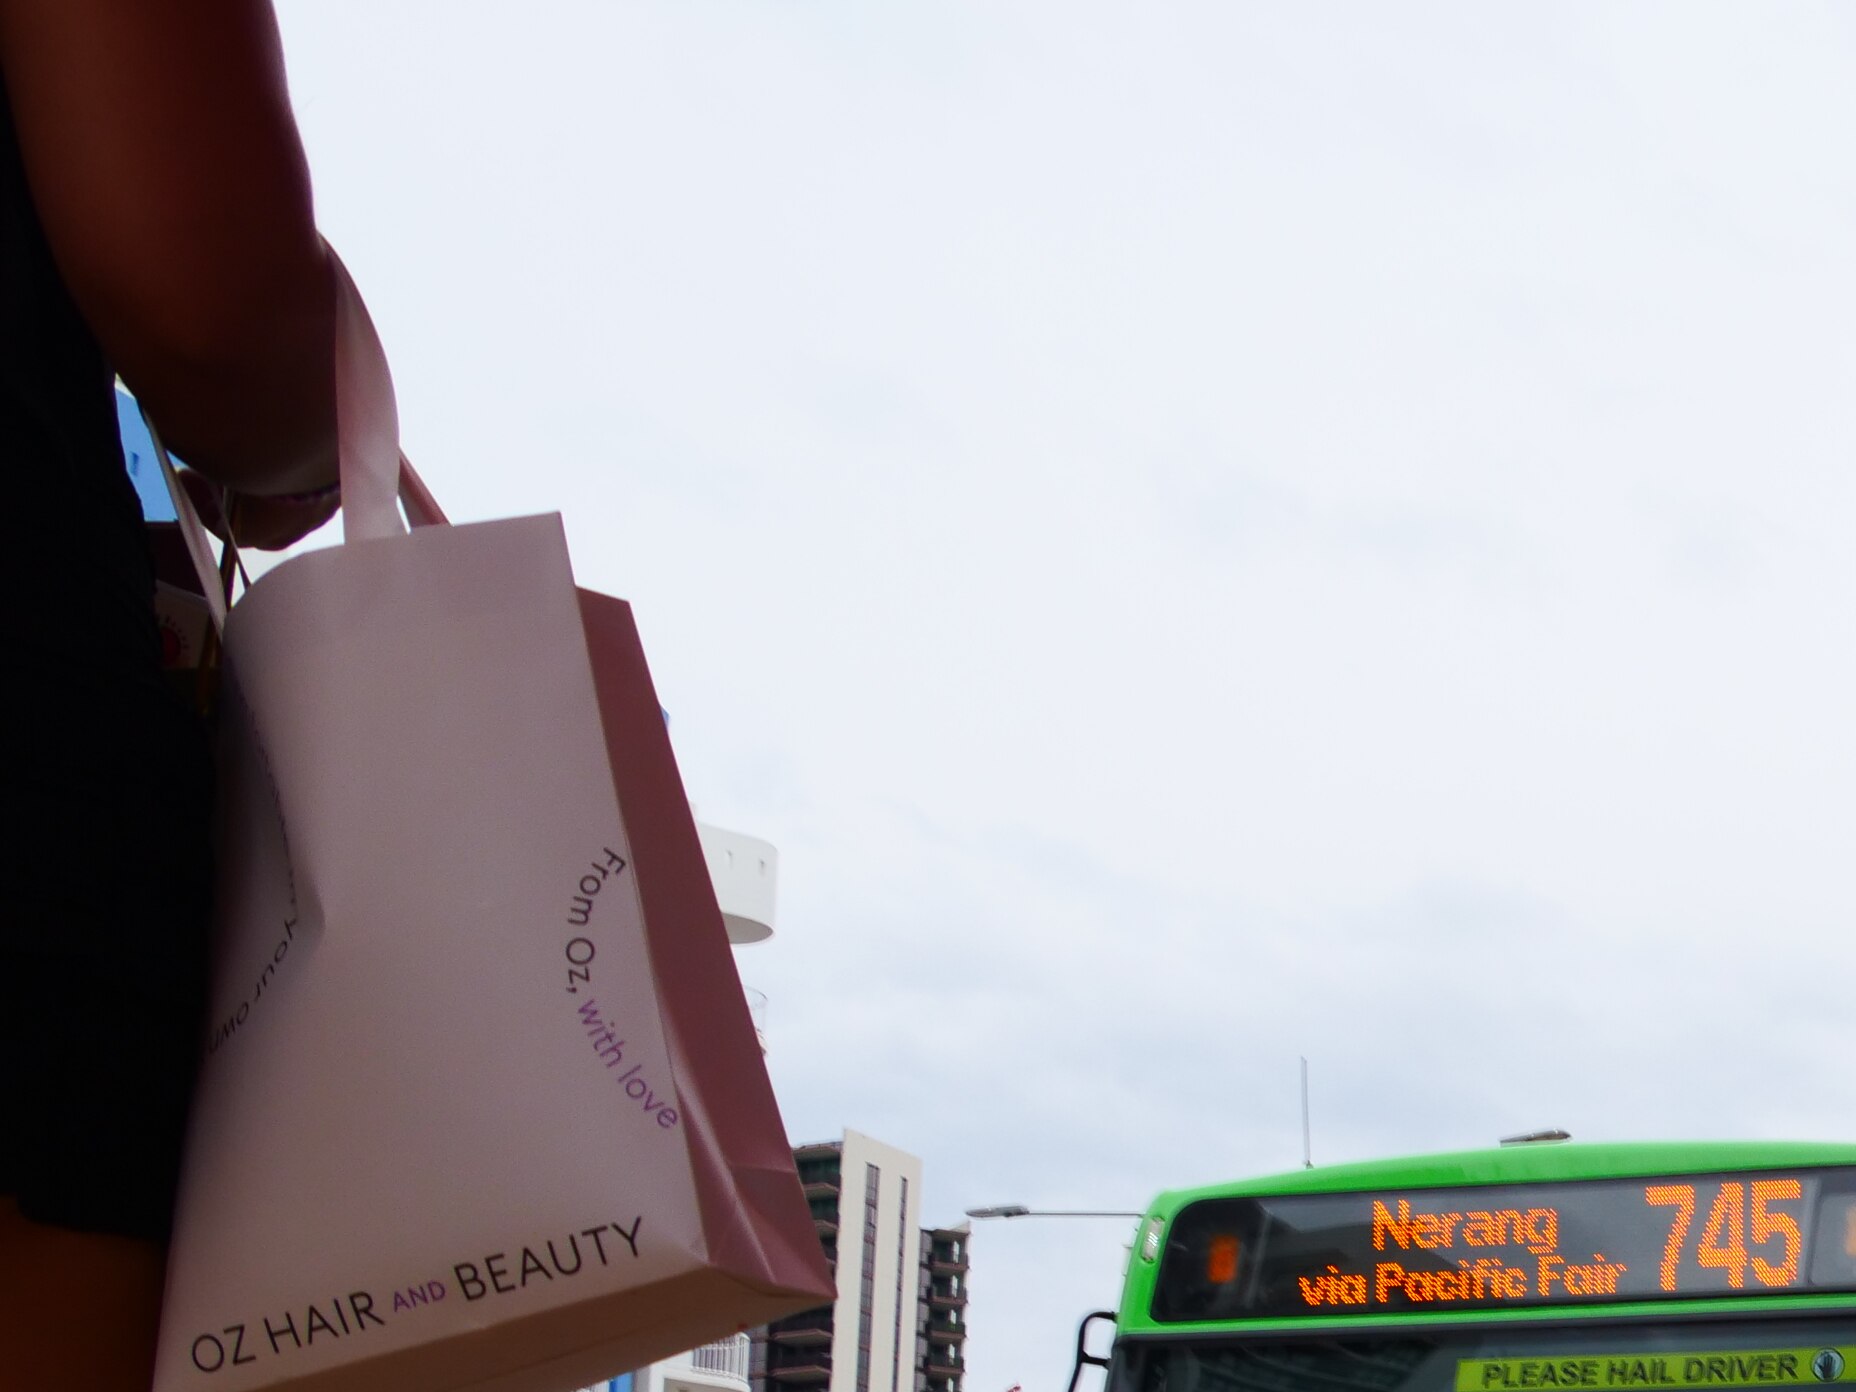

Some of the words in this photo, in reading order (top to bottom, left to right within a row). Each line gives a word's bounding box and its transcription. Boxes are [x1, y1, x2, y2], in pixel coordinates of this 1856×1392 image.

[568, 847, 626, 927] From
[564, 938, 595, 994] Oz,
[577, 998, 622, 1070] with
[617, 1064, 679, 1131] love
[1371, 1199, 1558, 1255] Nerang
[1645, 1178, 1801, 1292] 745
[191, 1324, 256, 1374] OZ
[263, 1291, 385, 1355] HAIR
[391, 1280, 447, 1314] AND
[454, 1216, 645, 1302] BEAUTY
[1299, 1264, 1367, 1307] via
[1375, 1256, 1527, 1305] Pacific
[1538, 1253, 1628, 1297] Fair
[1481, 1359, 1602, 1391] PLEASE
[1606, 1357, 1678, 1385] HAIL
[1685, 1352, 1799, 1383] DRIVER
